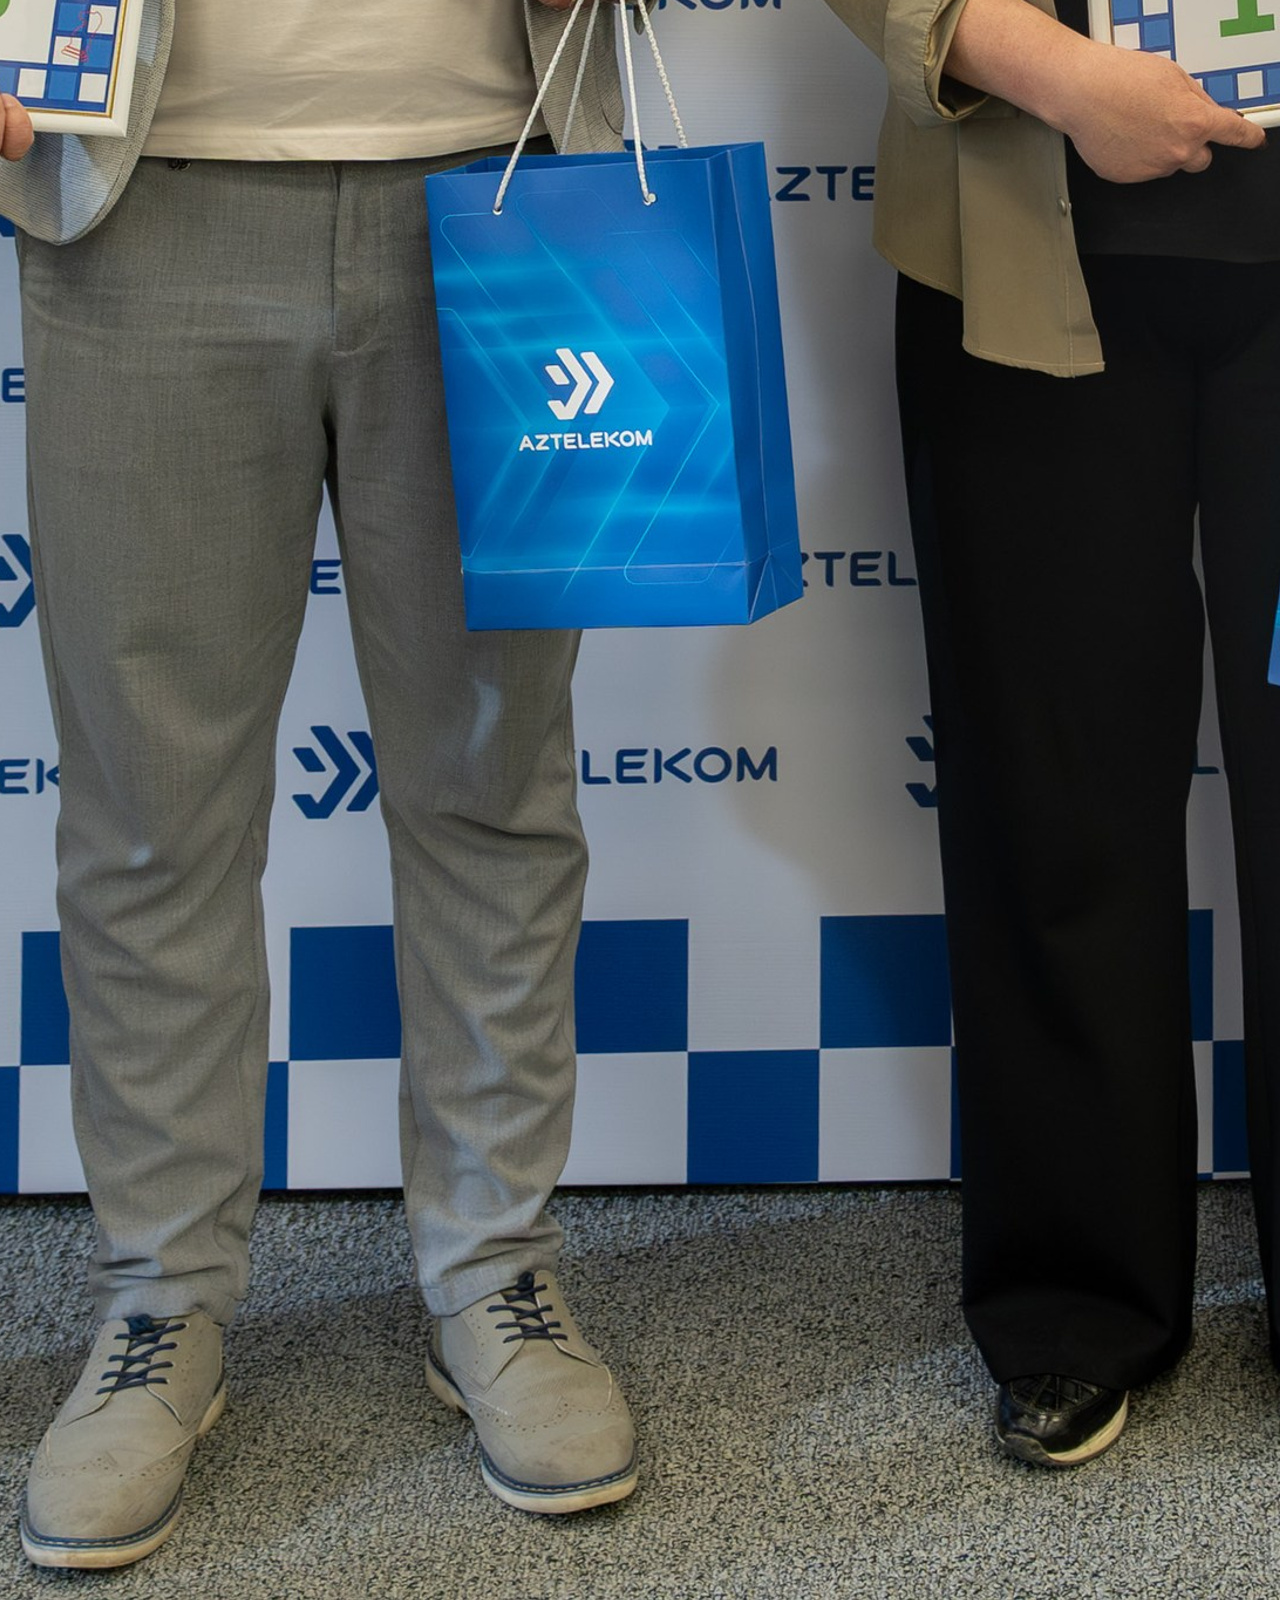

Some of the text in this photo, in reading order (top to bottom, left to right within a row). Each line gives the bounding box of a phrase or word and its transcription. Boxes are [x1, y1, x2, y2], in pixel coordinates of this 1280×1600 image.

[771, 166, 876, 201] ZTE
[519, 429, 653, 451] AZTELEKOM
[801, 551, 917, 587] TEL
[581, 746, 777, 785] LEKOM
